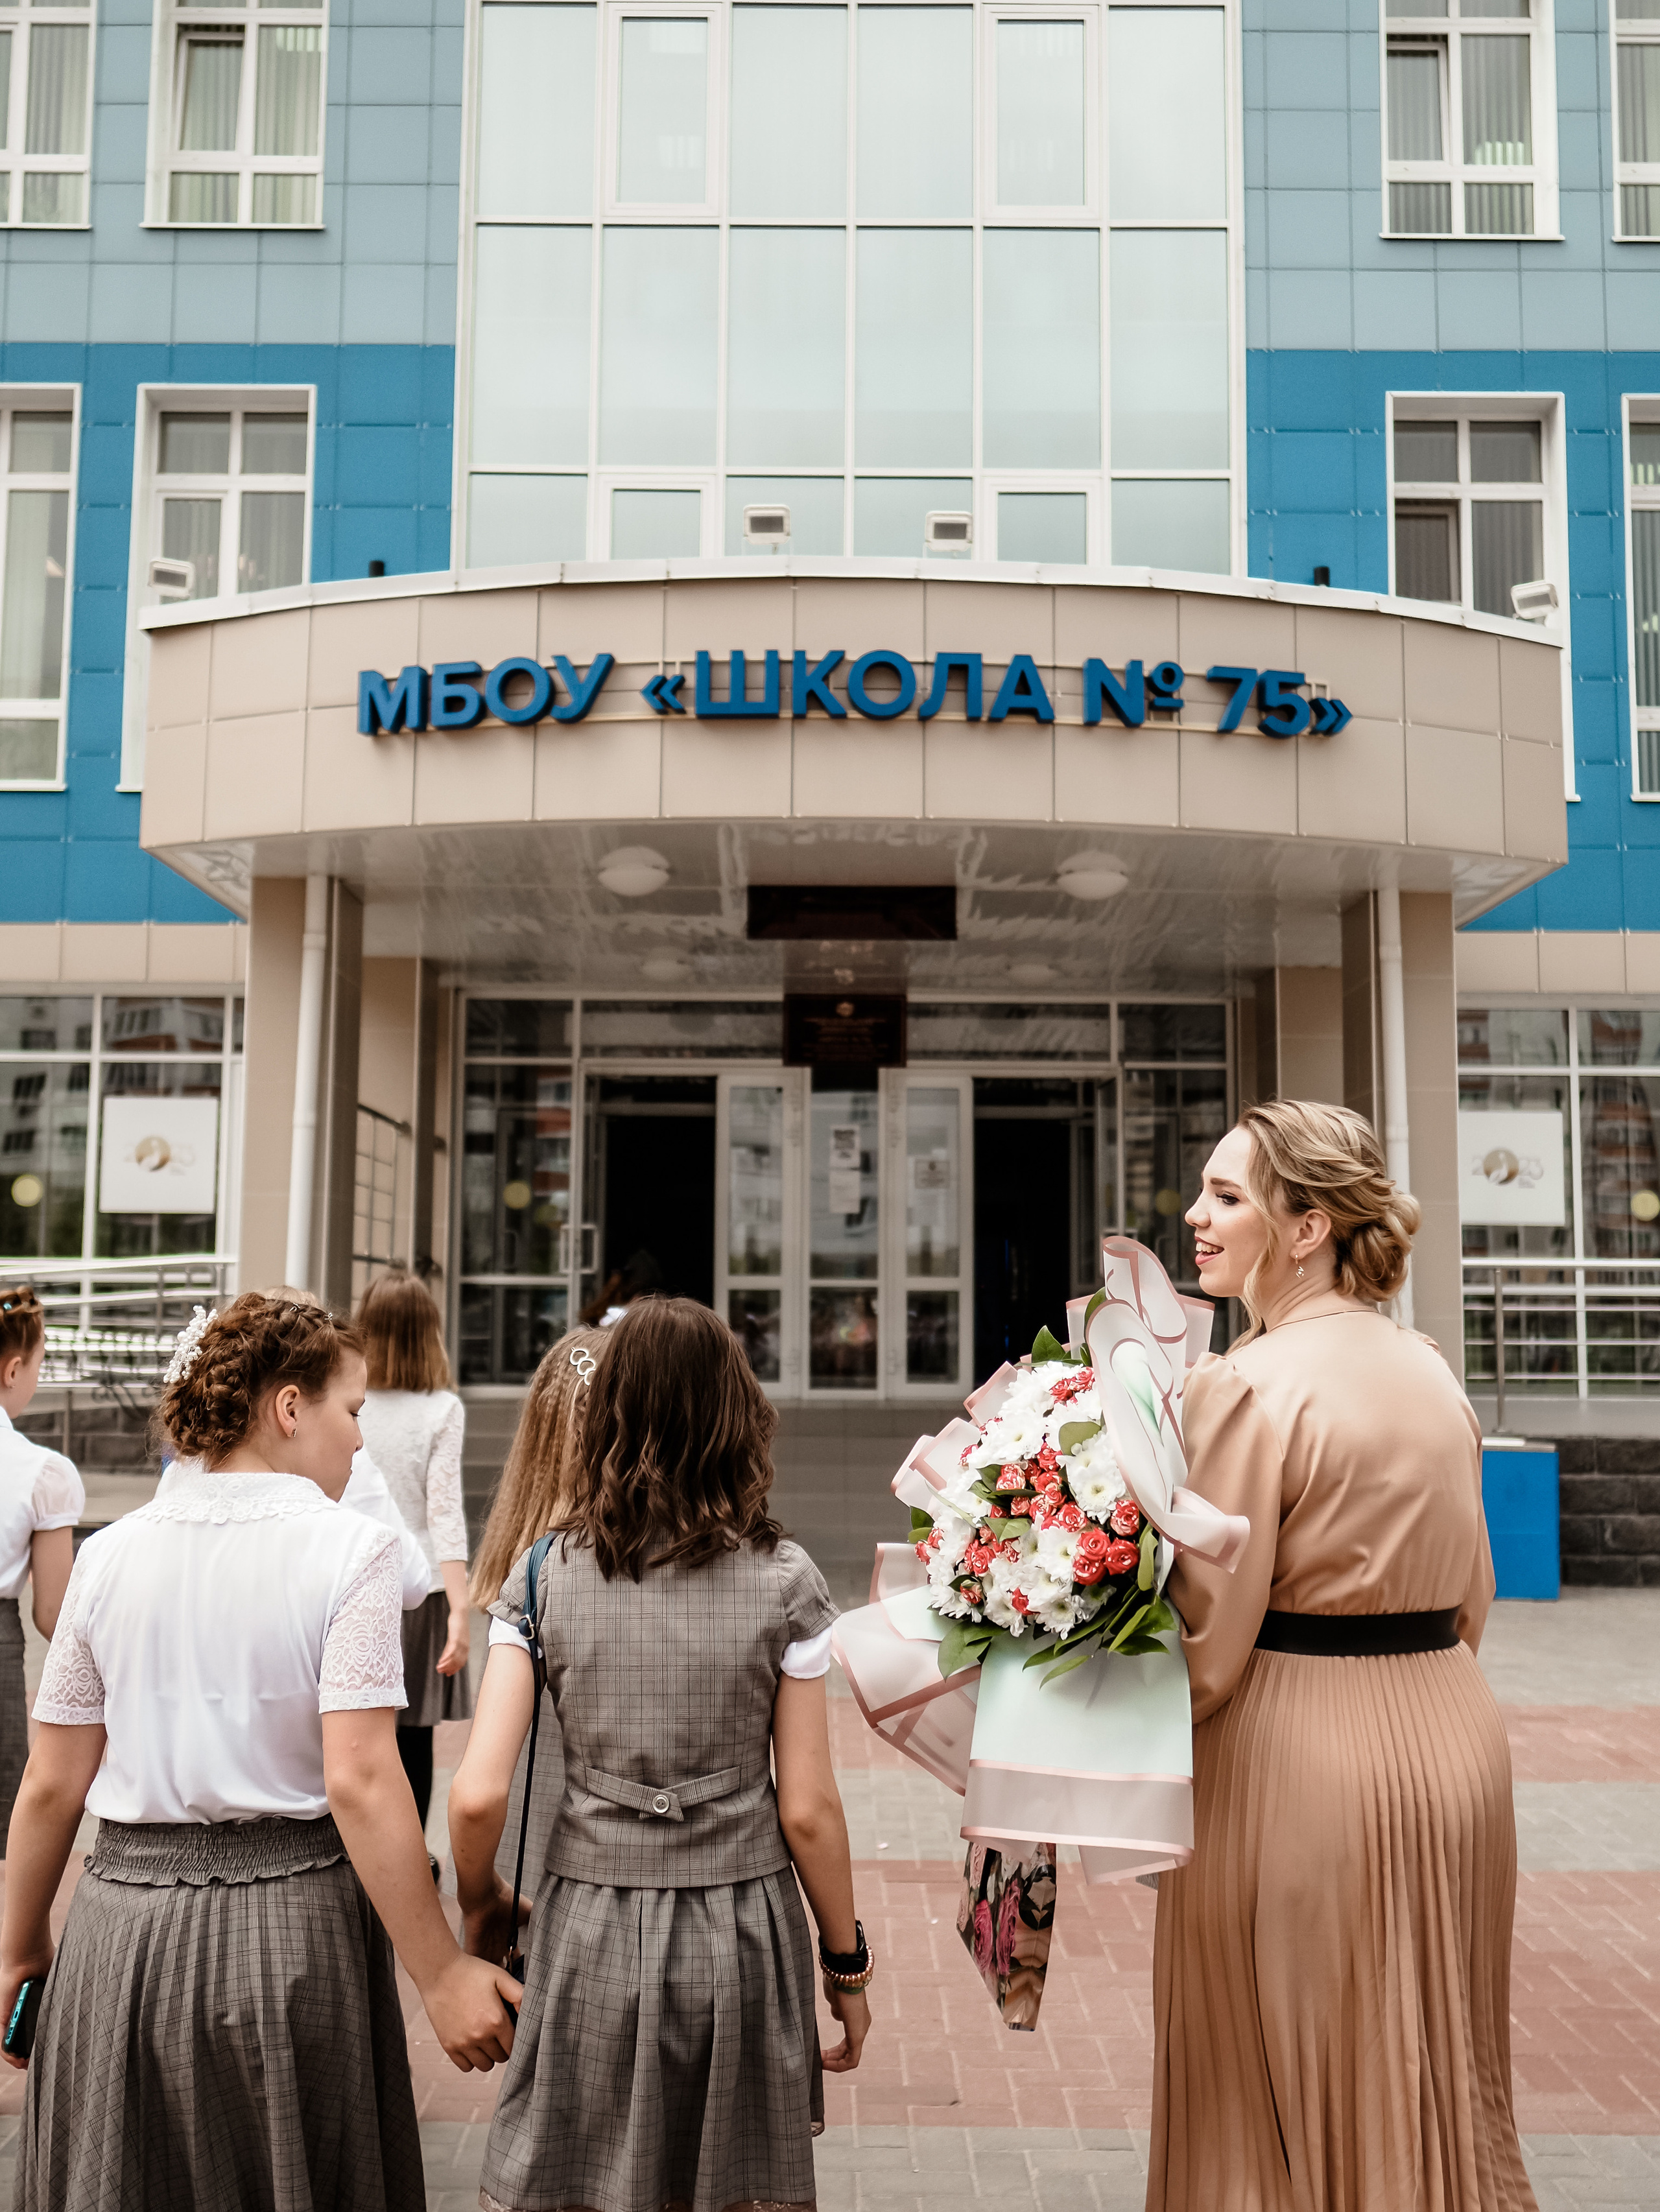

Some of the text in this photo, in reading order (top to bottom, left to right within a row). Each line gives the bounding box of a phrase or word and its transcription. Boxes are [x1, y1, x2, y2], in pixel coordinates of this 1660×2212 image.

[357, 650, 1354, 738] МБОУ «ШКОЛА № 75»
